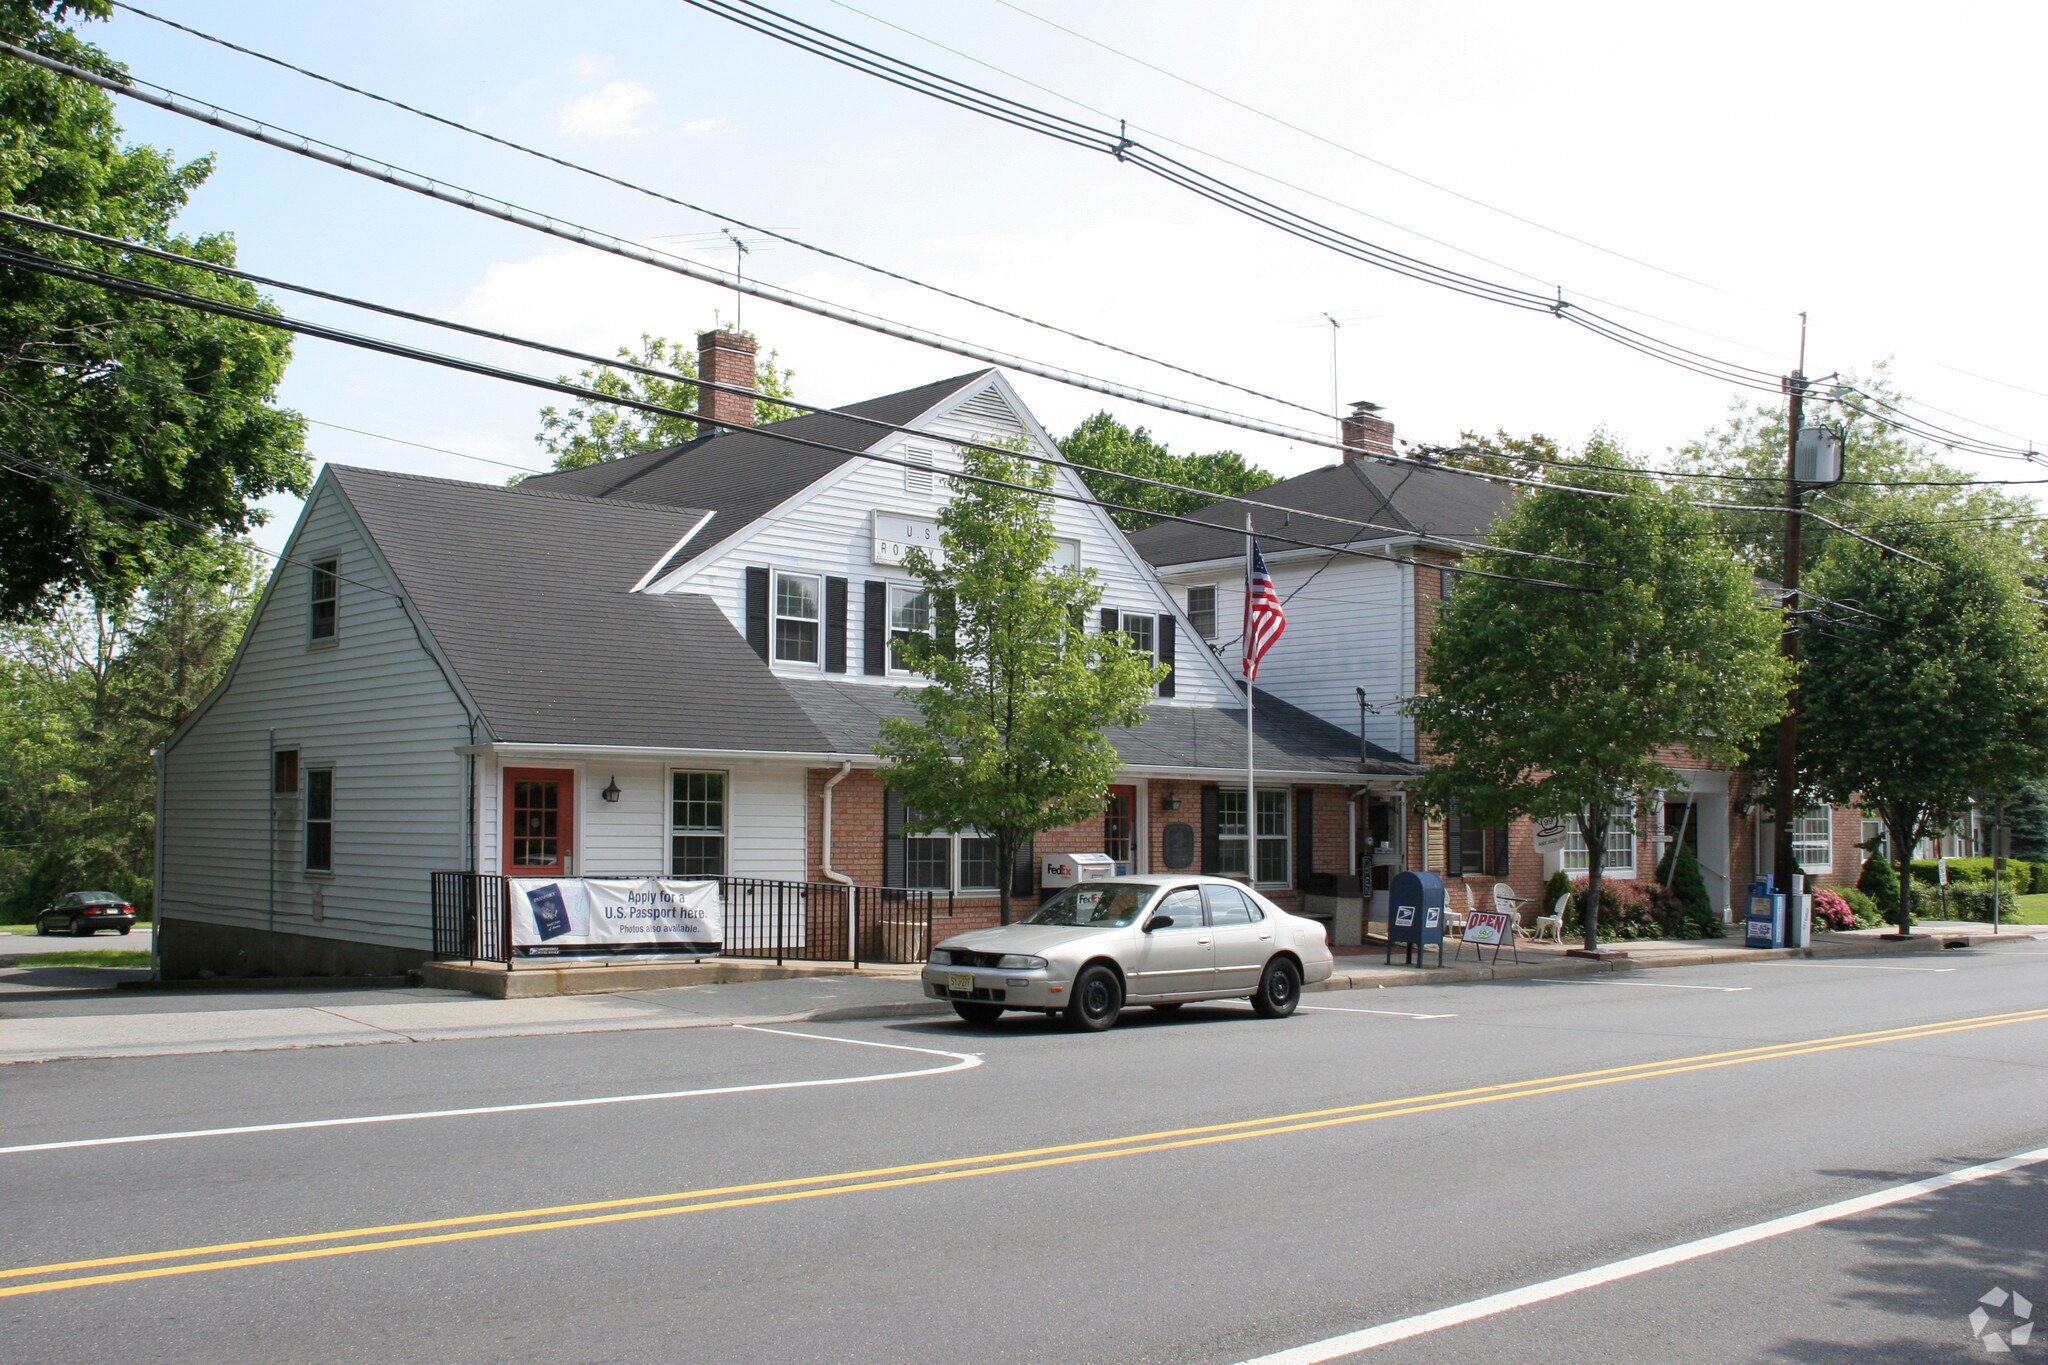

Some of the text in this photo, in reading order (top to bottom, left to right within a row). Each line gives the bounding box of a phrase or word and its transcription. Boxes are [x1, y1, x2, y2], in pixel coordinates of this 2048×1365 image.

[906, 525, 937, 541] U.S.
[1047, 863, 1072, 876] FedEx
[627, 890, 686, 905] Apply for a
[604, 906, 708, 920] U.S. Passport here.
[619, 923, 700, 934] Photos also available.
[1468, 913, 1505, 934] OPEN
